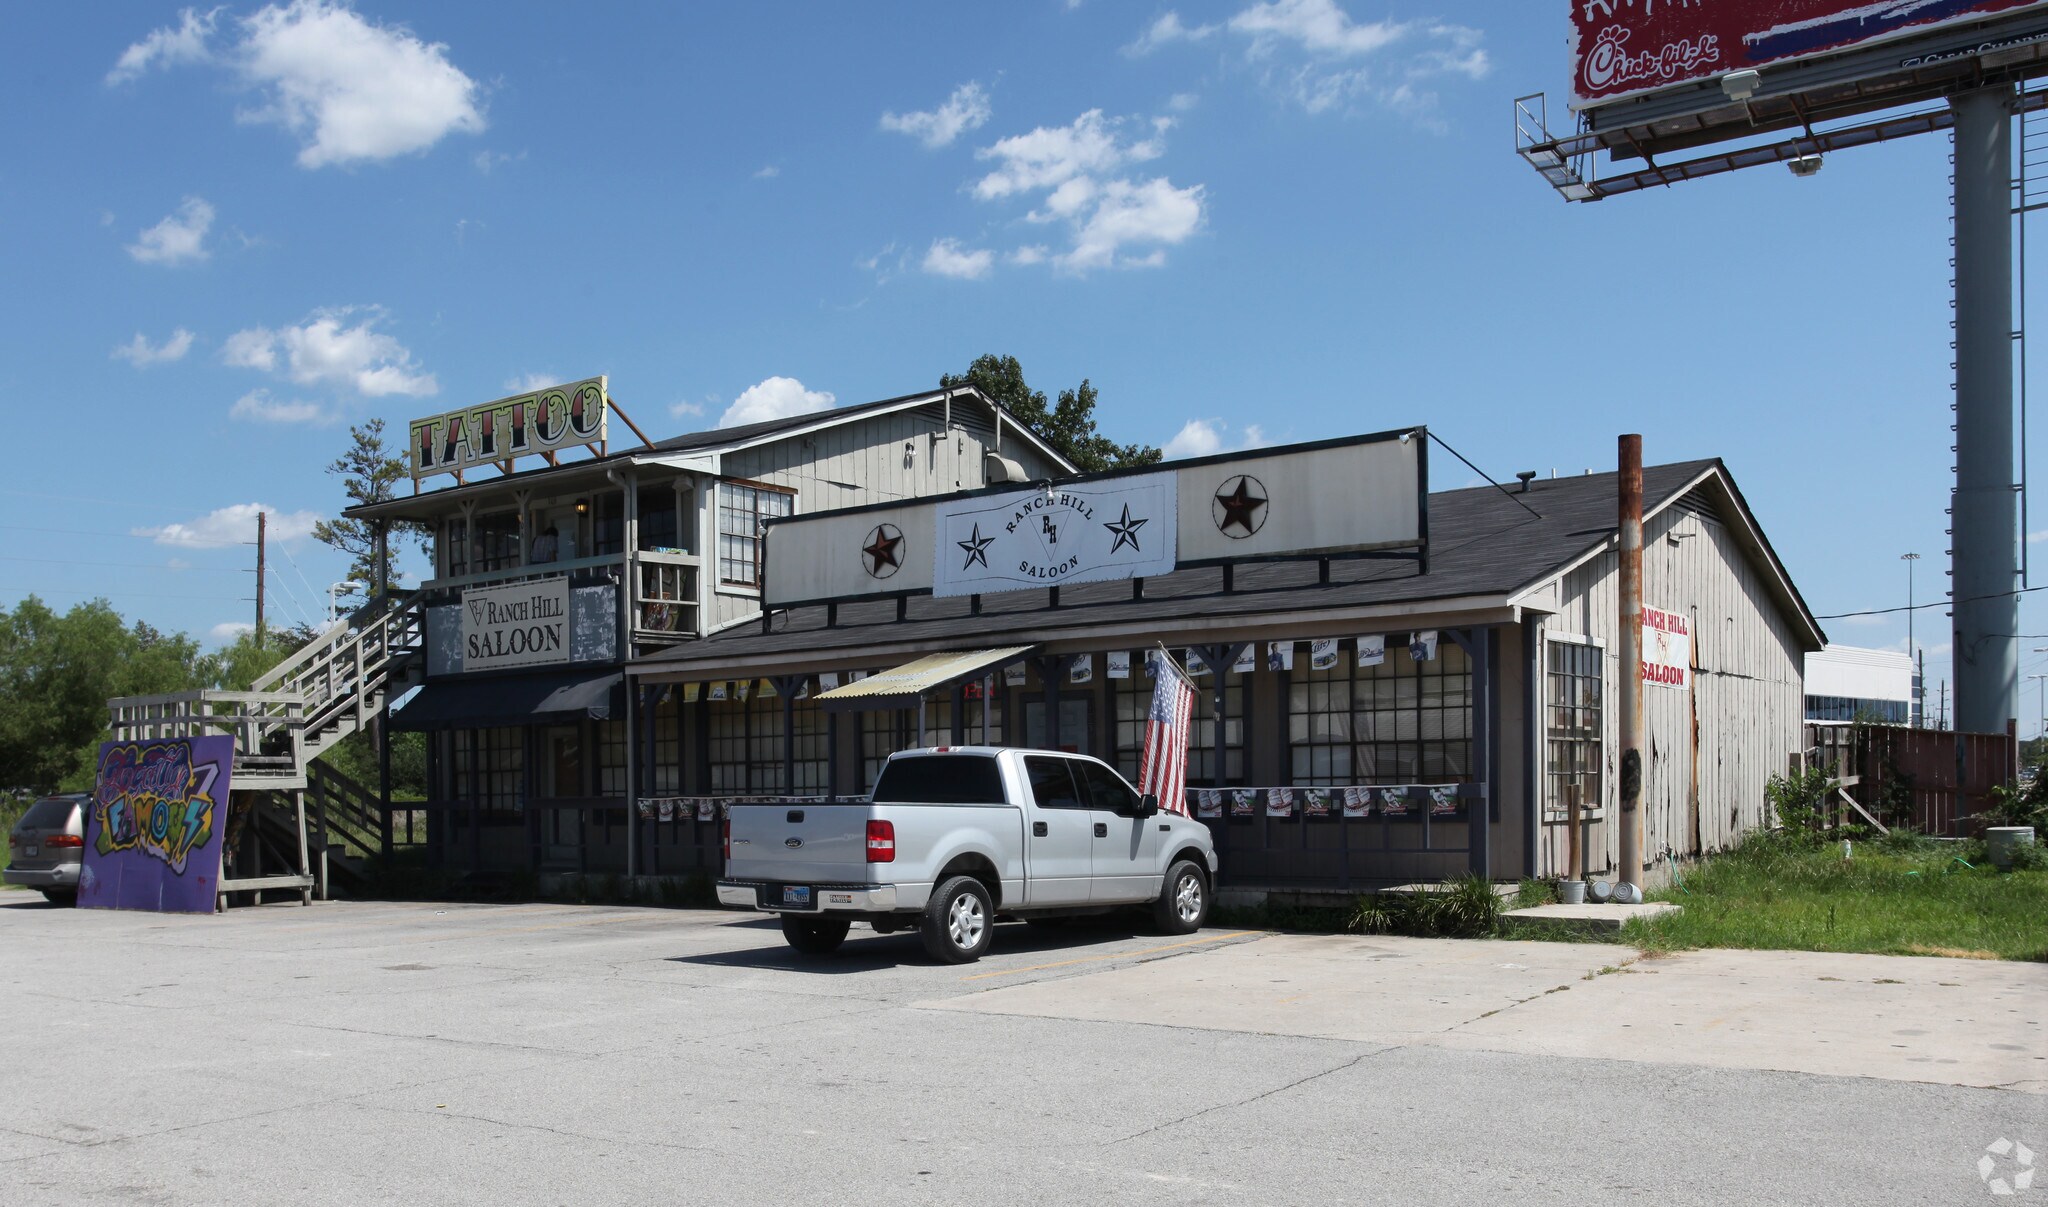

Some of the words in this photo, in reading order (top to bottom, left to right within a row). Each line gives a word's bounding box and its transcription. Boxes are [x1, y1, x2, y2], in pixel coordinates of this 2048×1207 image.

[410, 380, 605, 473] TATTOO
[1060, 494, 1094, 521] HILL
[1019, 554, 1079, 579] SALOON
[487, 601, 529, 625] RANCH
[531, 595, 564, 620] HILL
[1641, 607, 1666, 631] ANCH
[1667, 613, 1688, 636] HILL
[467, 623, 564, 660] SALOON
[1641, 660, 1684, 686] SALOON
[107, 796, 210, 855] FAMOUS
